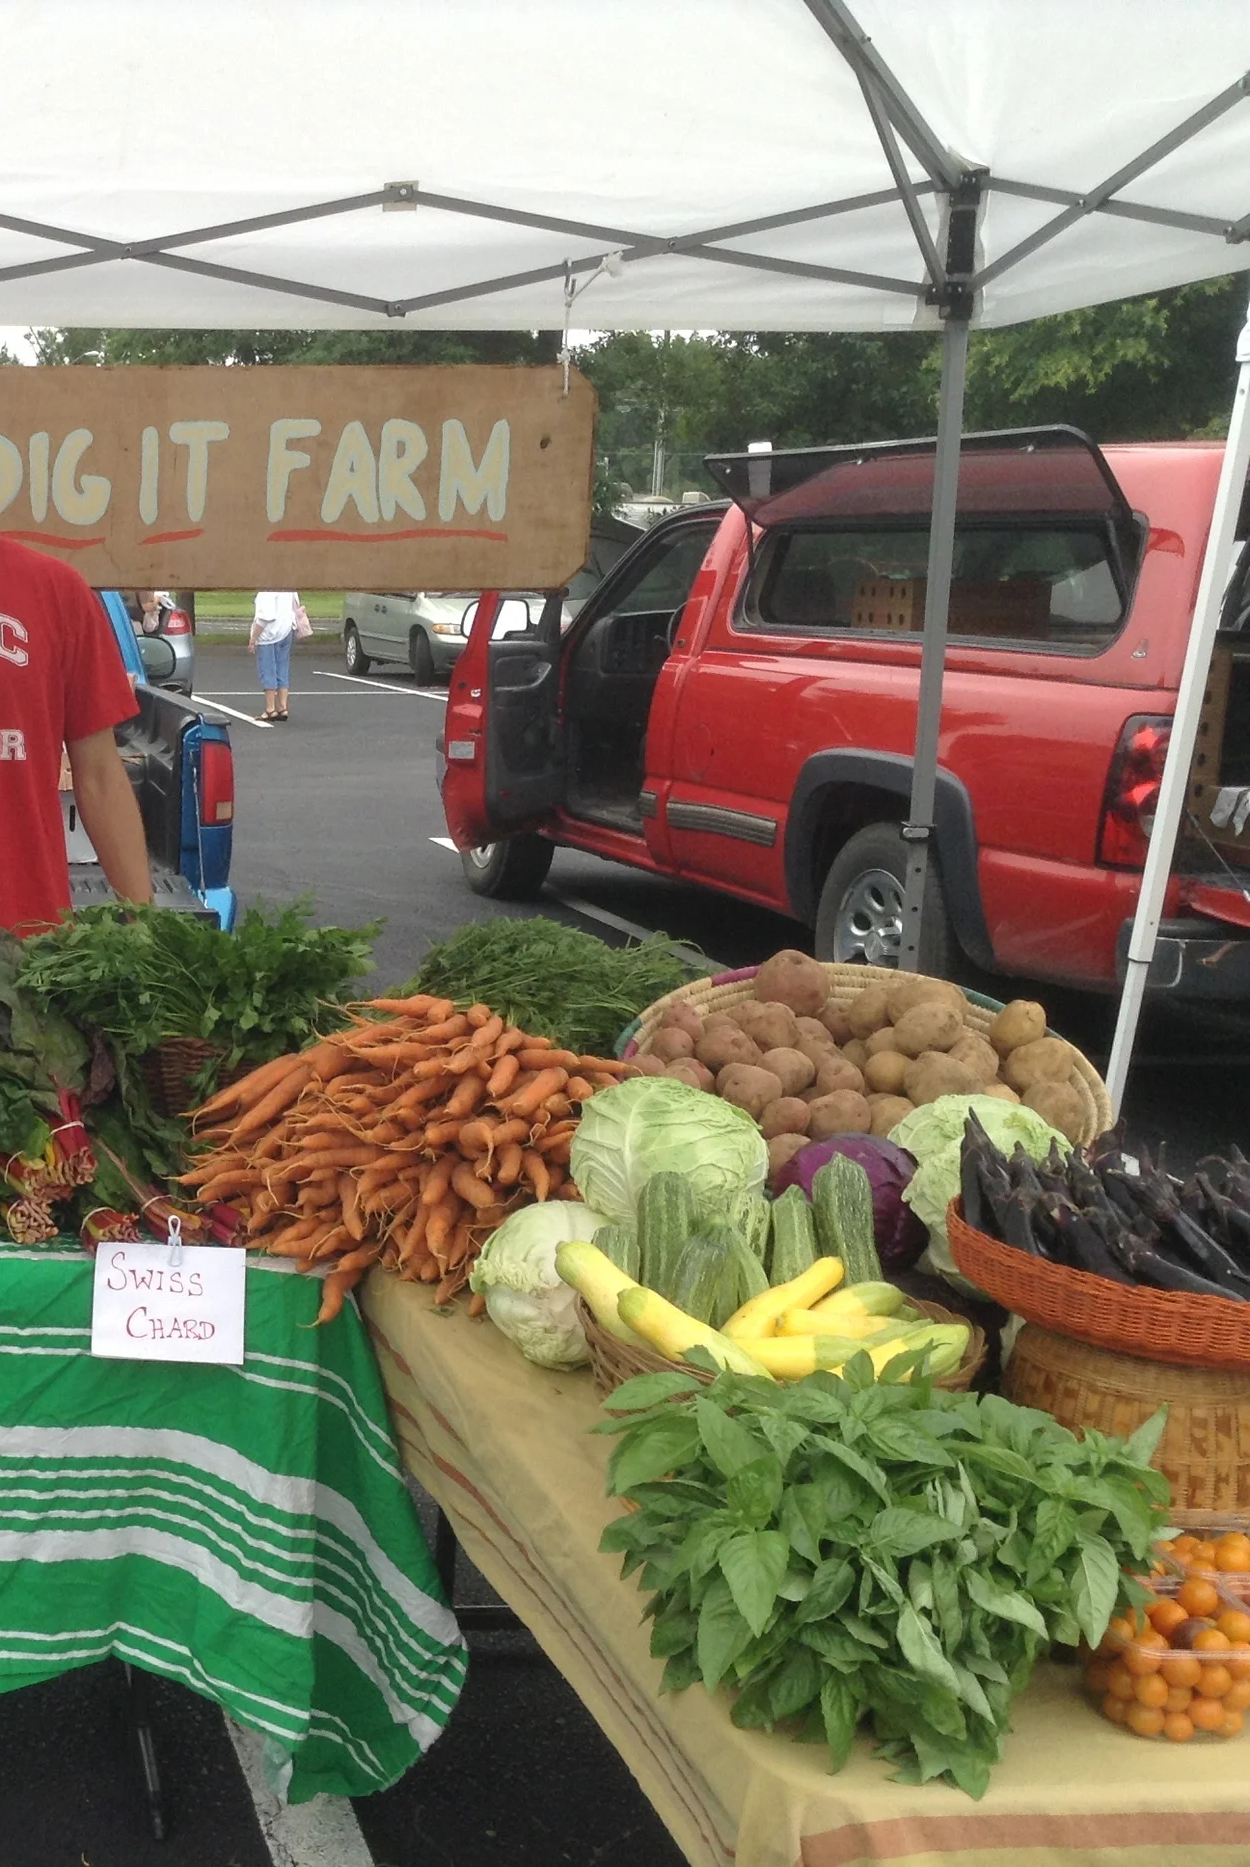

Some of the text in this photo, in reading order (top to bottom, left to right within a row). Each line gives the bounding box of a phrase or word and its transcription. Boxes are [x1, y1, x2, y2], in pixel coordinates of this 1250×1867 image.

[140, 420, 230, 525] IT
[266, 418, 510, 524] FARM
[107, 1251, 203, 1296] SWISS
[126, 1306, 215, 1340] CHARD
